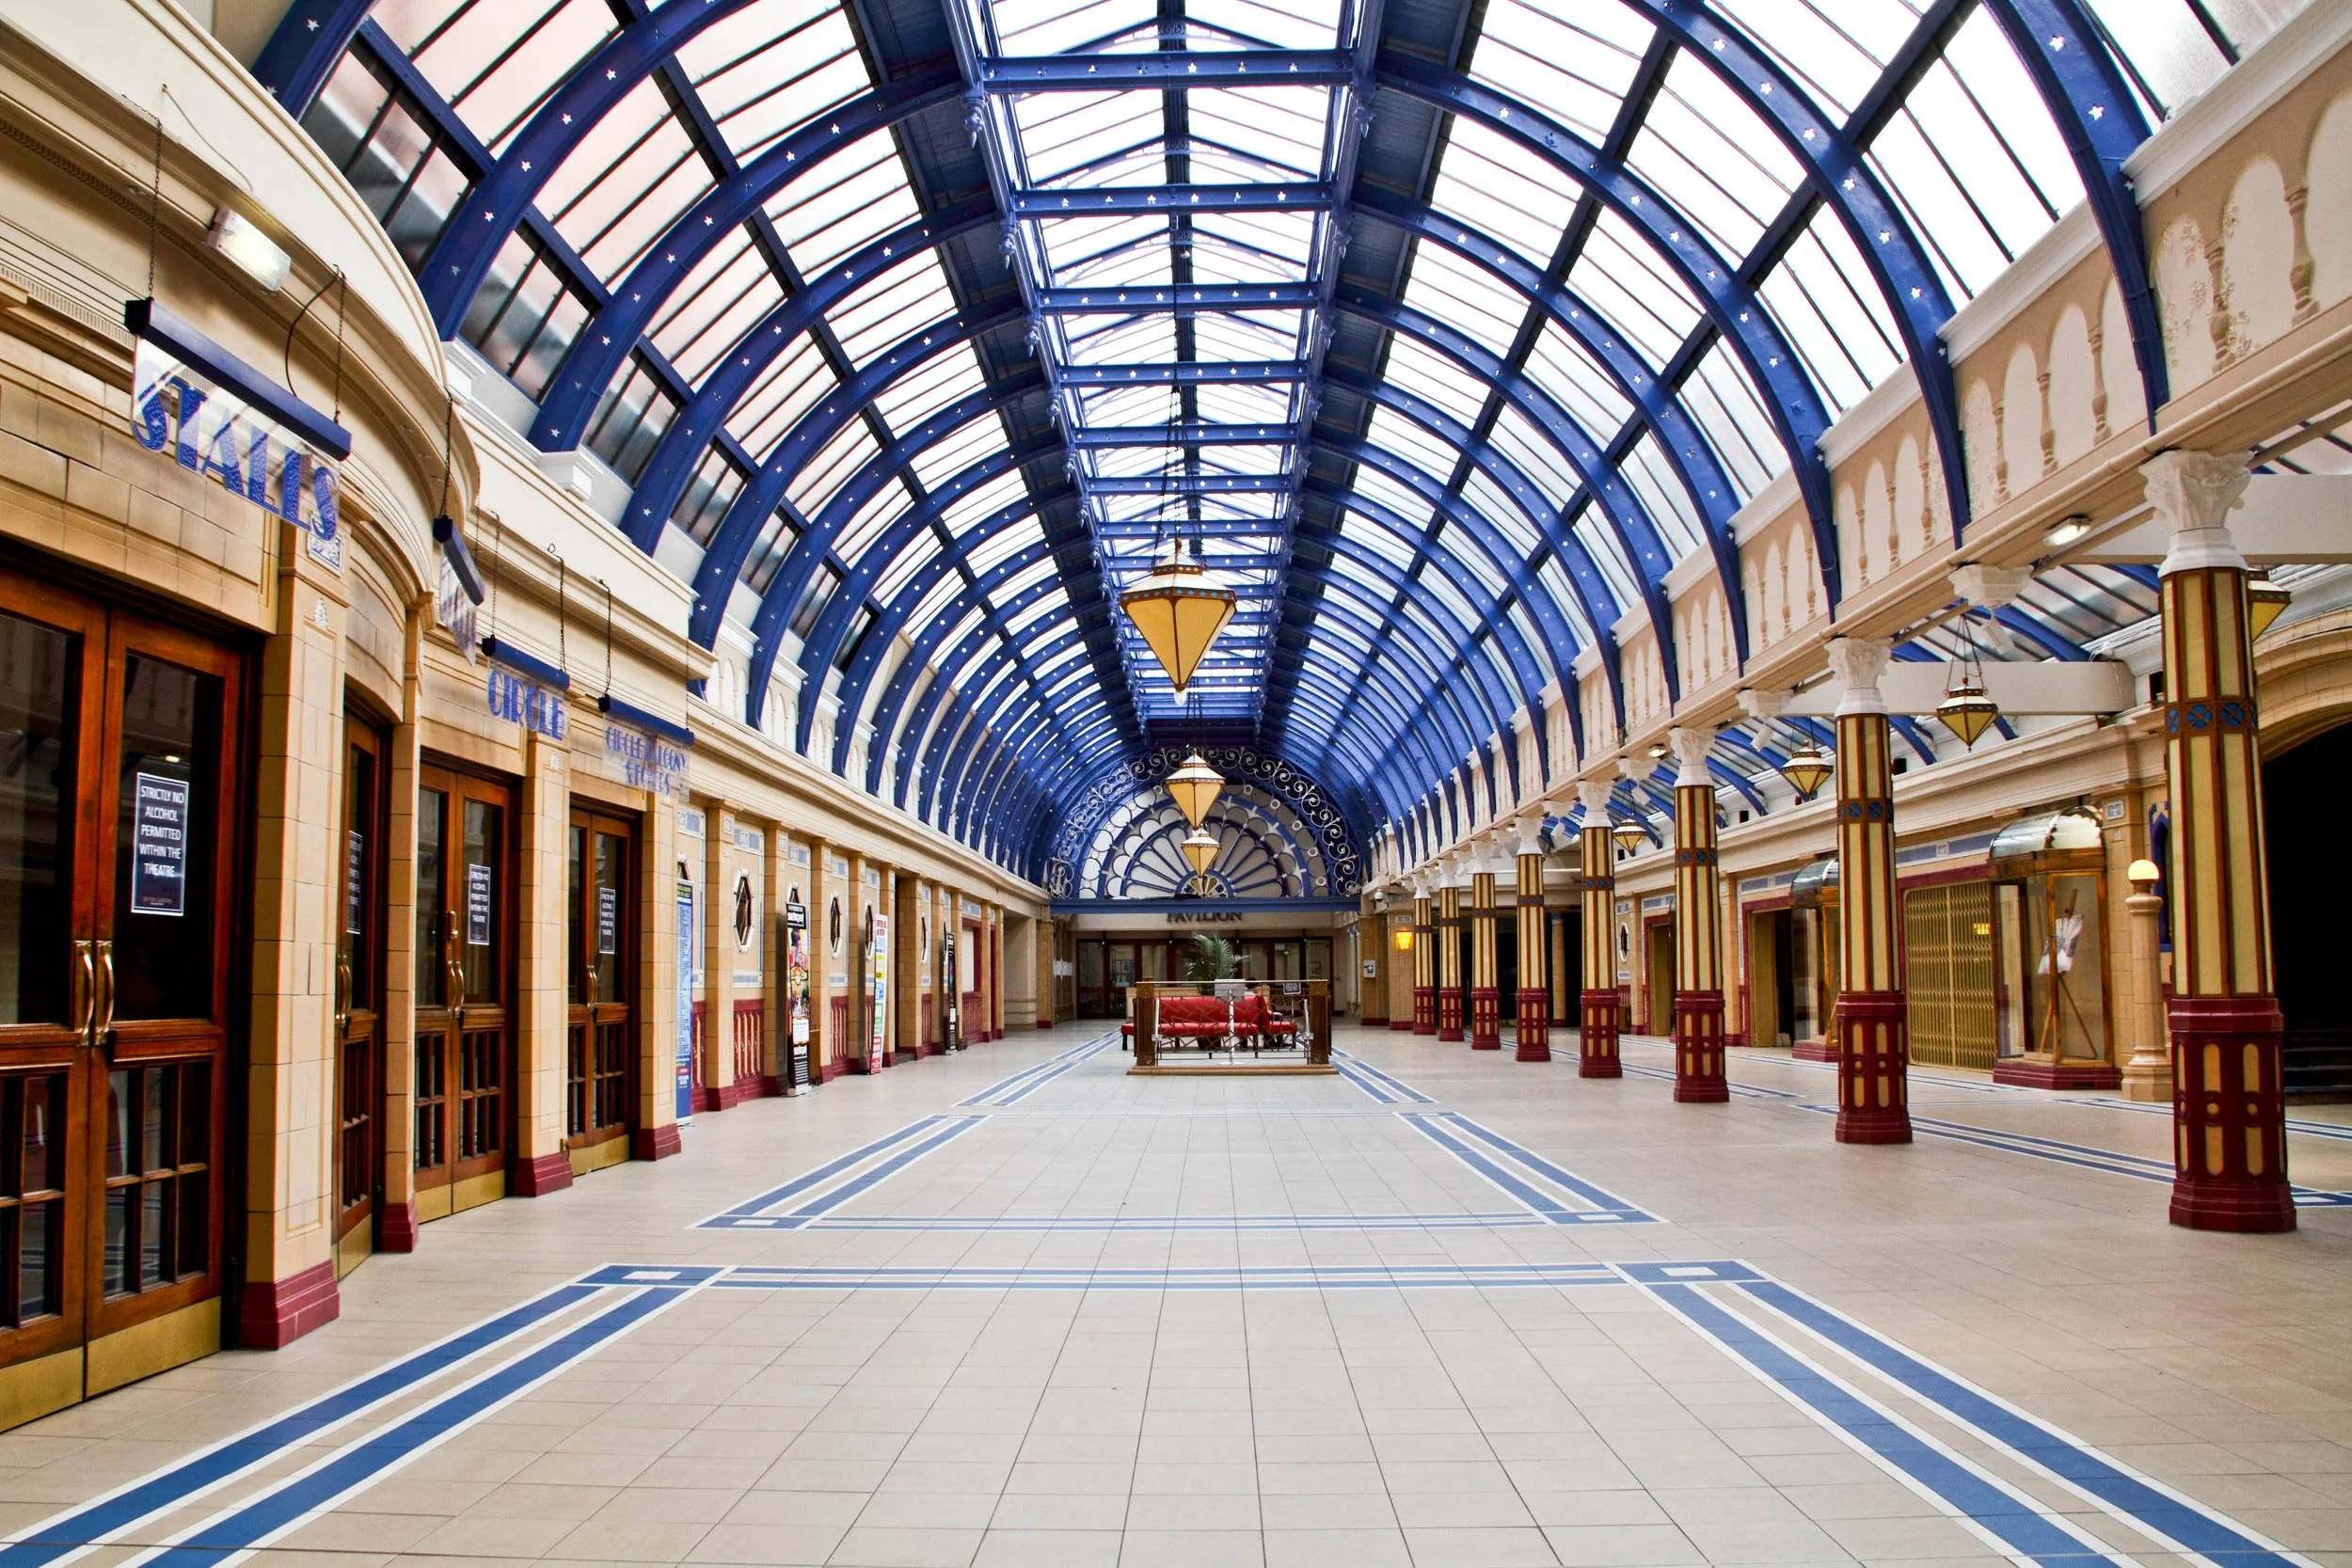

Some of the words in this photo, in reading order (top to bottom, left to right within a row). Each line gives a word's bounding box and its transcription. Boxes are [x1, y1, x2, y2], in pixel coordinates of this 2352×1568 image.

[133, 360, 338, 542] STALLS
[488, 669, 564, 741] CIRCLE
[606, 726, 644, 760] CIRCLE
[141, 785, 172, 800] STRICTLY
[173, 792, 184, 803] NO
[145, 806, 179, 821] ALCOHOL
[140, 824, 182, 841] PERMITTED
[139, 843, 166, 858] WITHIN
[167, 847, 182, 860] THE
[144, 863, 176, 877] THEATRE
[1167, 912, 1242, 922] PAVILION
